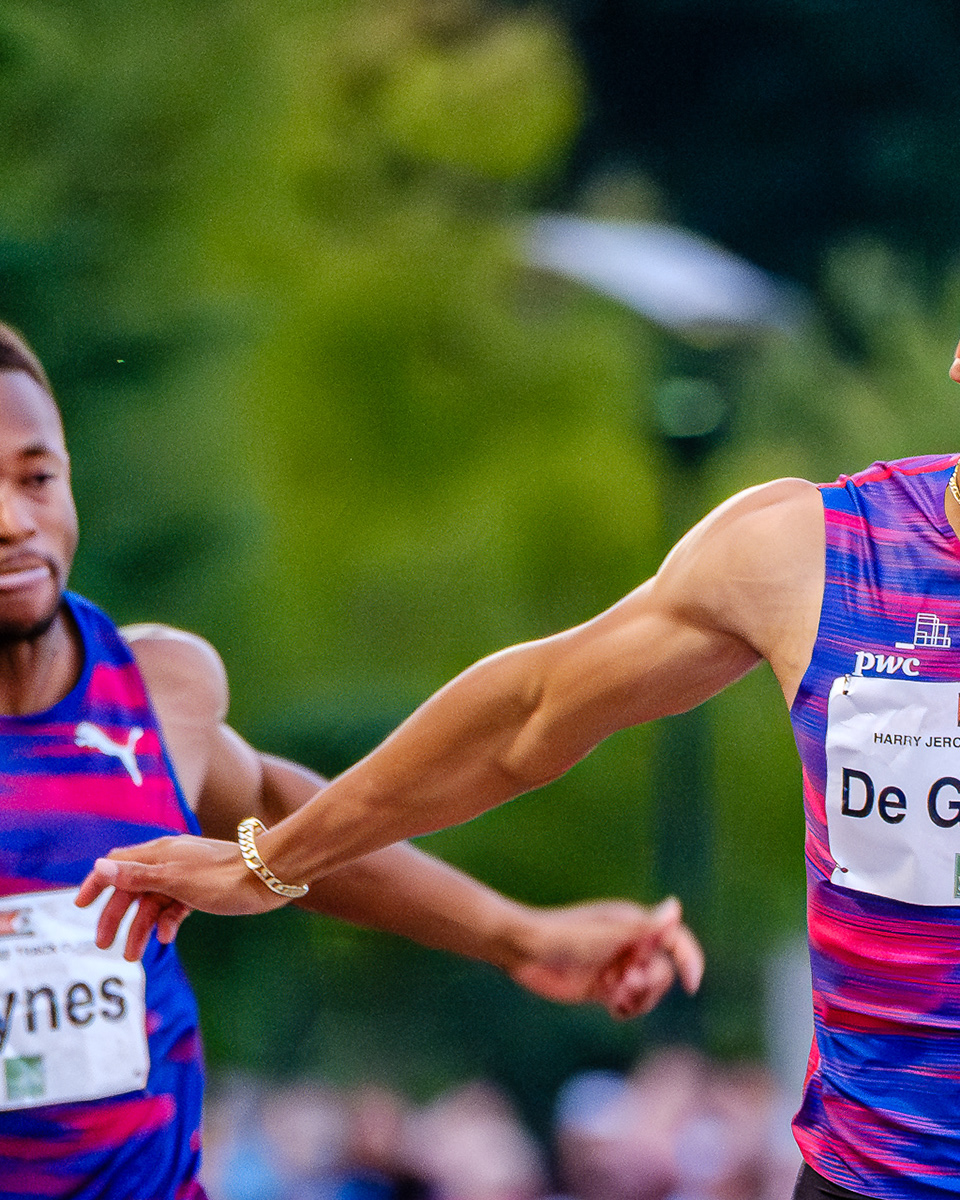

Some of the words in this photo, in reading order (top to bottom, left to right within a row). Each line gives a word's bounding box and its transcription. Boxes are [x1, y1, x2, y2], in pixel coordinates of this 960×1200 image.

[852, 651, 920, 676] pwc
[873, 732, 921, 747] HARRY
[841, 767, 907, 824] De
